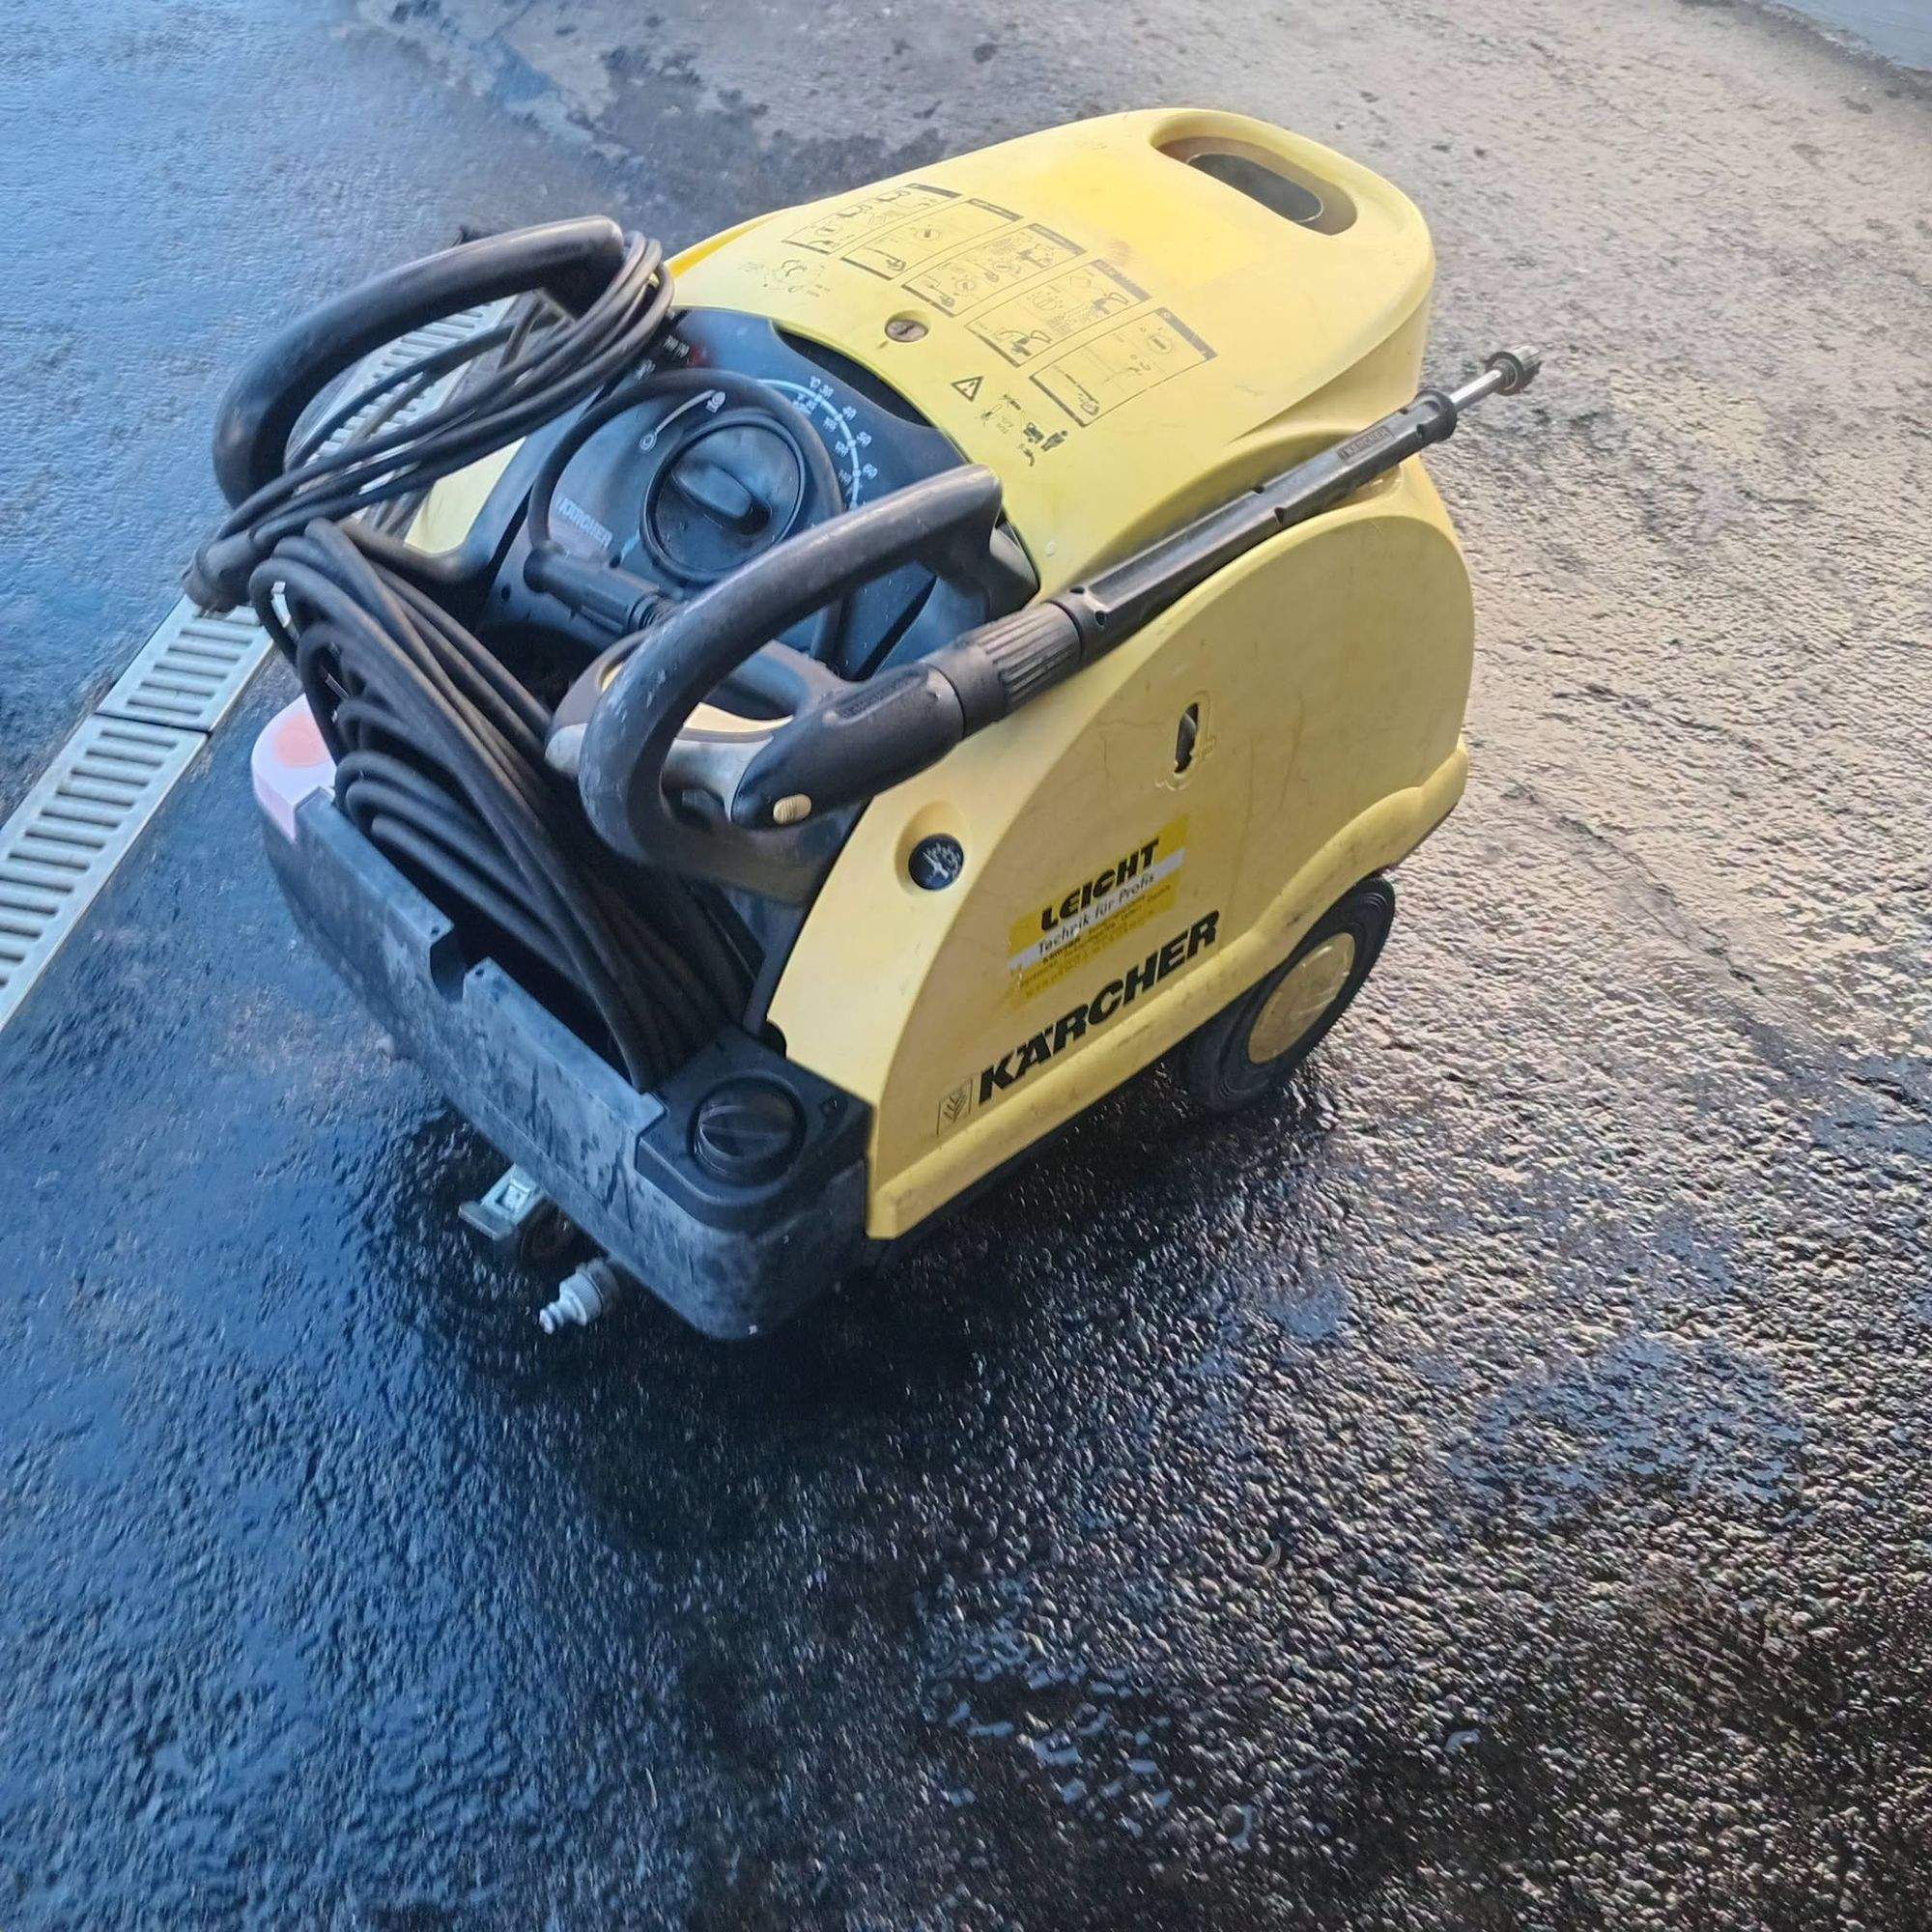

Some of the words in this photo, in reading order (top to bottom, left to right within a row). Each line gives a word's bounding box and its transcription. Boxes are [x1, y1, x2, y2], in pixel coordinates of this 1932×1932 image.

[1038, 915, 1090, 956] Technik
[1094, 898, 1114, 919] für
[1118, 872, 1155, 905] Profis
[1040, 837, 1160, 932] LEICHT
[978, 909, 1220, 1105] KÄRCHER
